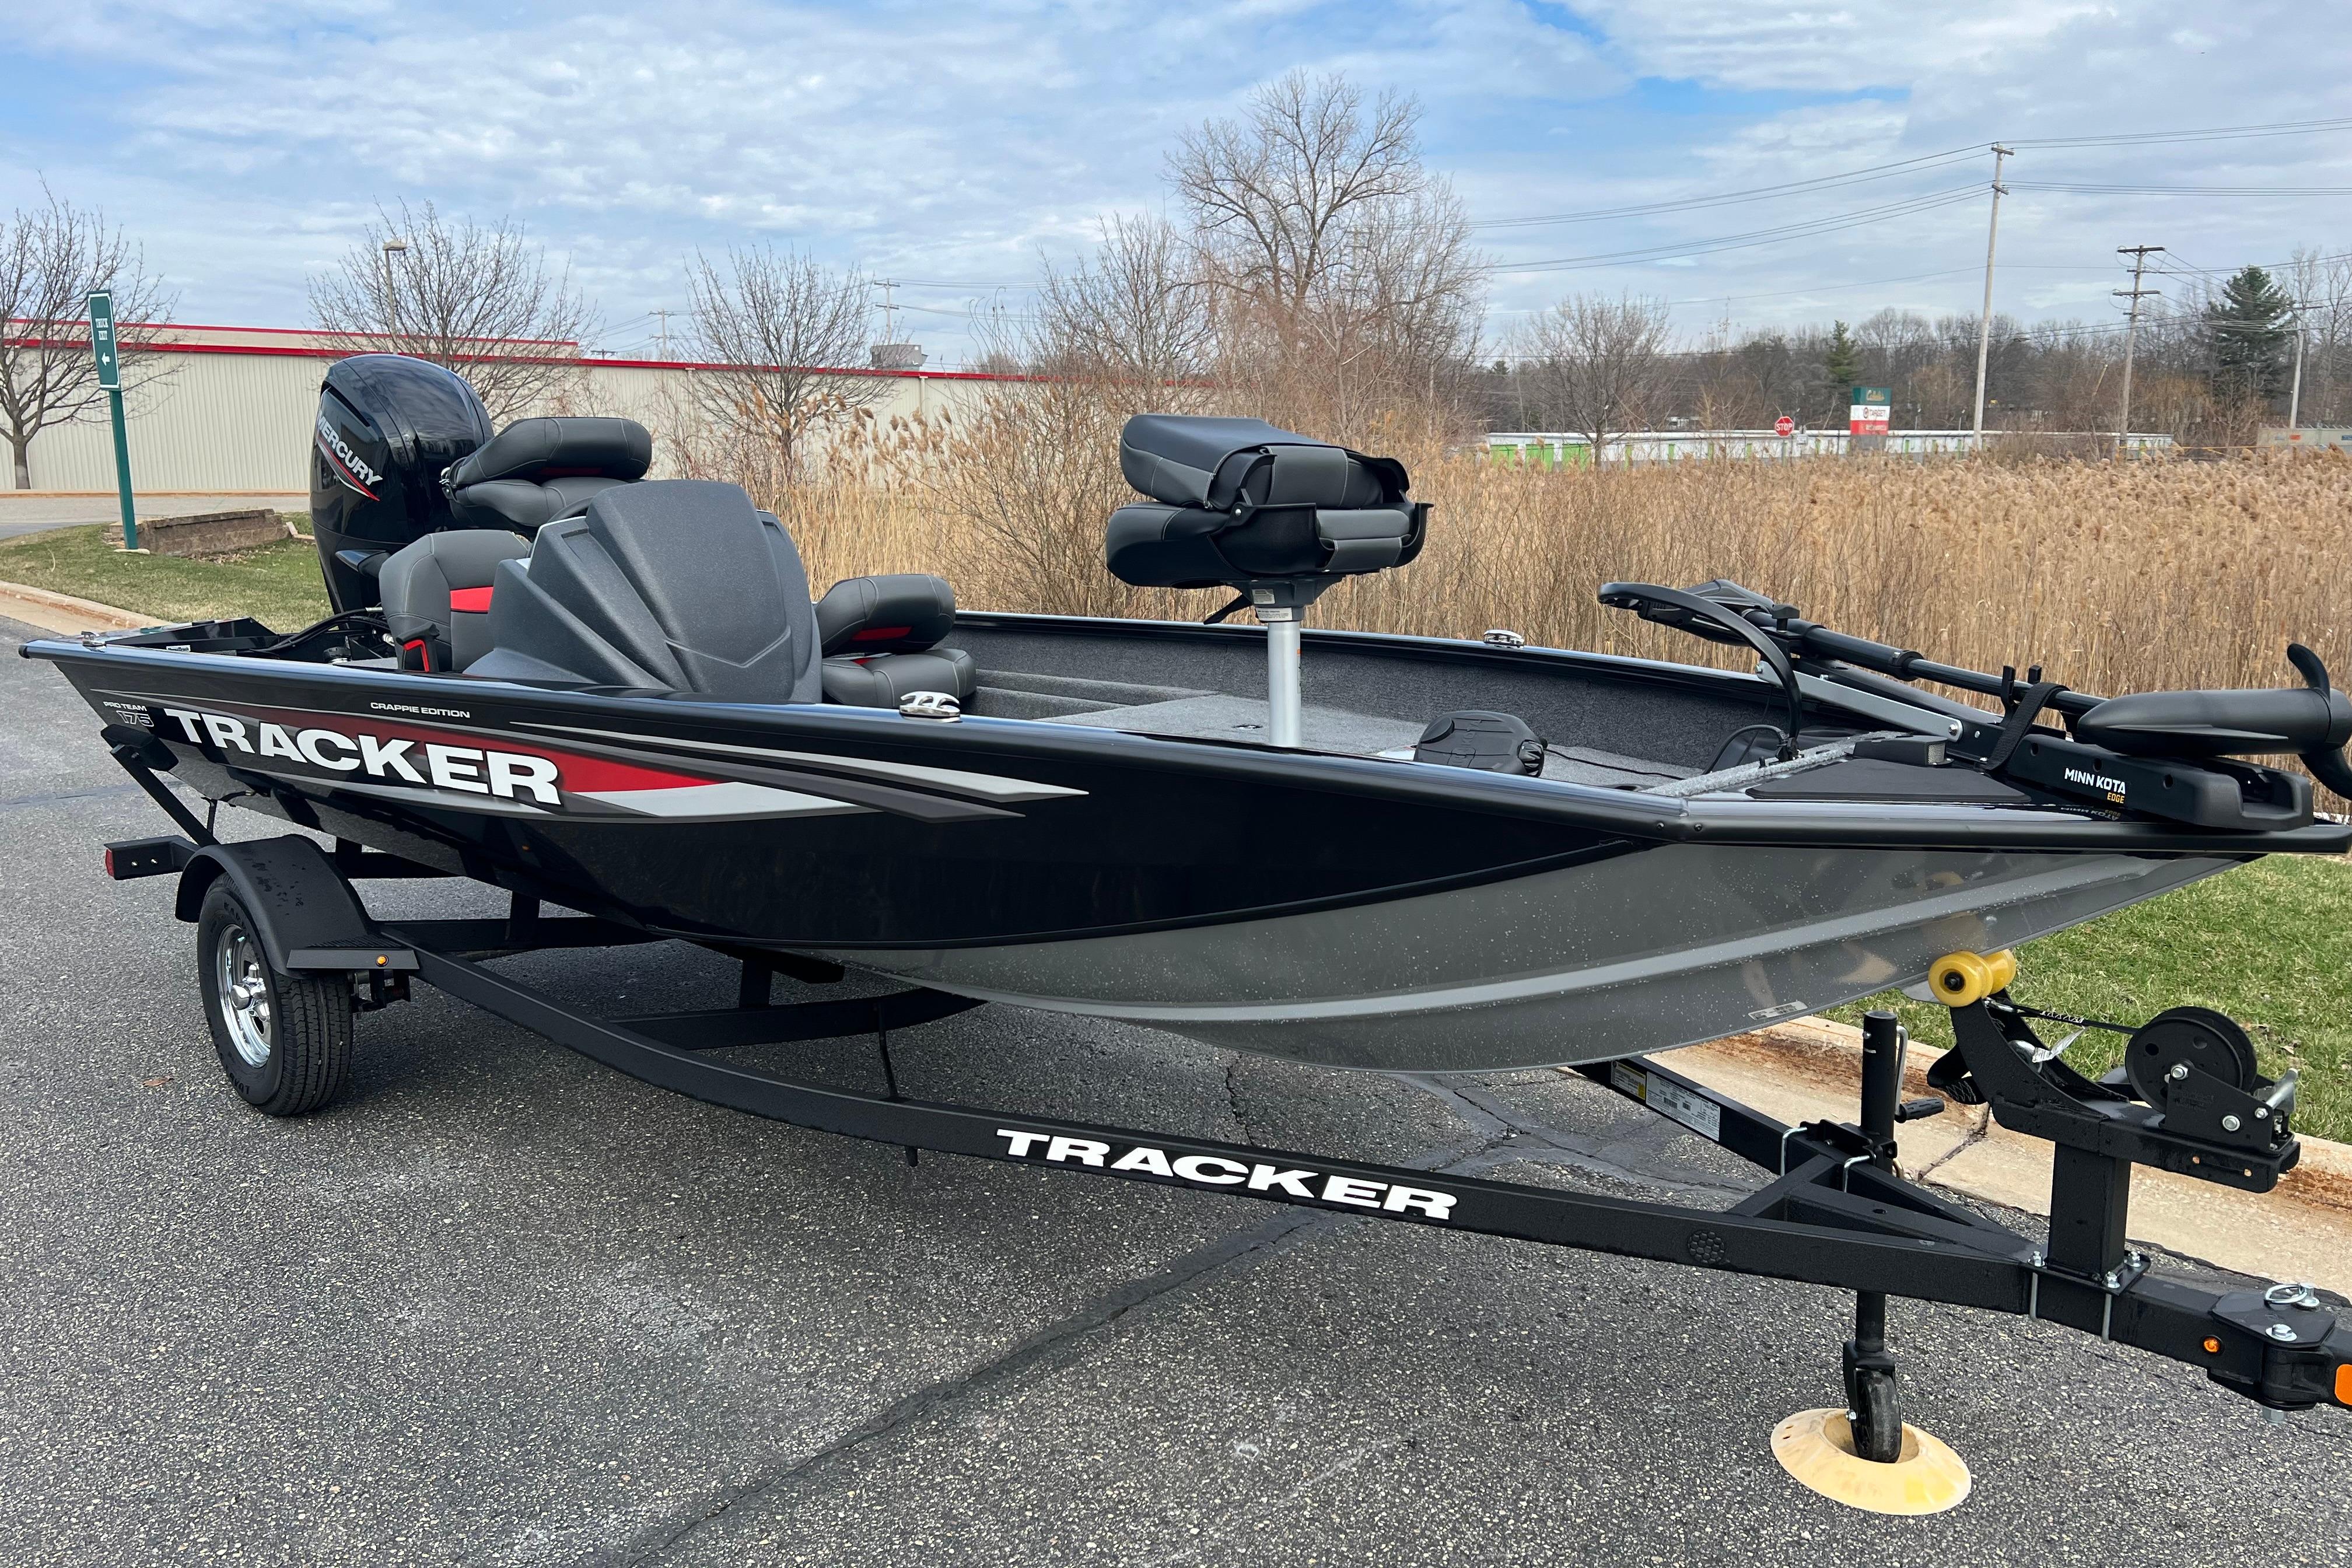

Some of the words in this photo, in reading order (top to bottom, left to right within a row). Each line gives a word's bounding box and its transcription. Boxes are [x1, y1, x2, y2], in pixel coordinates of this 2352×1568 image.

[1776, 423, 1793, 431] STOP
[317, 410, 383, 486] MERCURY
[120, 703, 148, 712] TEAM
[370, 702, 420, 713] CRAPPIE
[421, 707, 470, 718] EDITION
[116, 710, 154, 727] 175
[163, 708, 563, 807] TRACKER
[2064, 768, 2095, 786] MINN
[2096, 775, 2126, 794] KOTA
[2107, 792, 2125, 804] EDGE
[996, 1128, 1458, 1220] TRACKER
